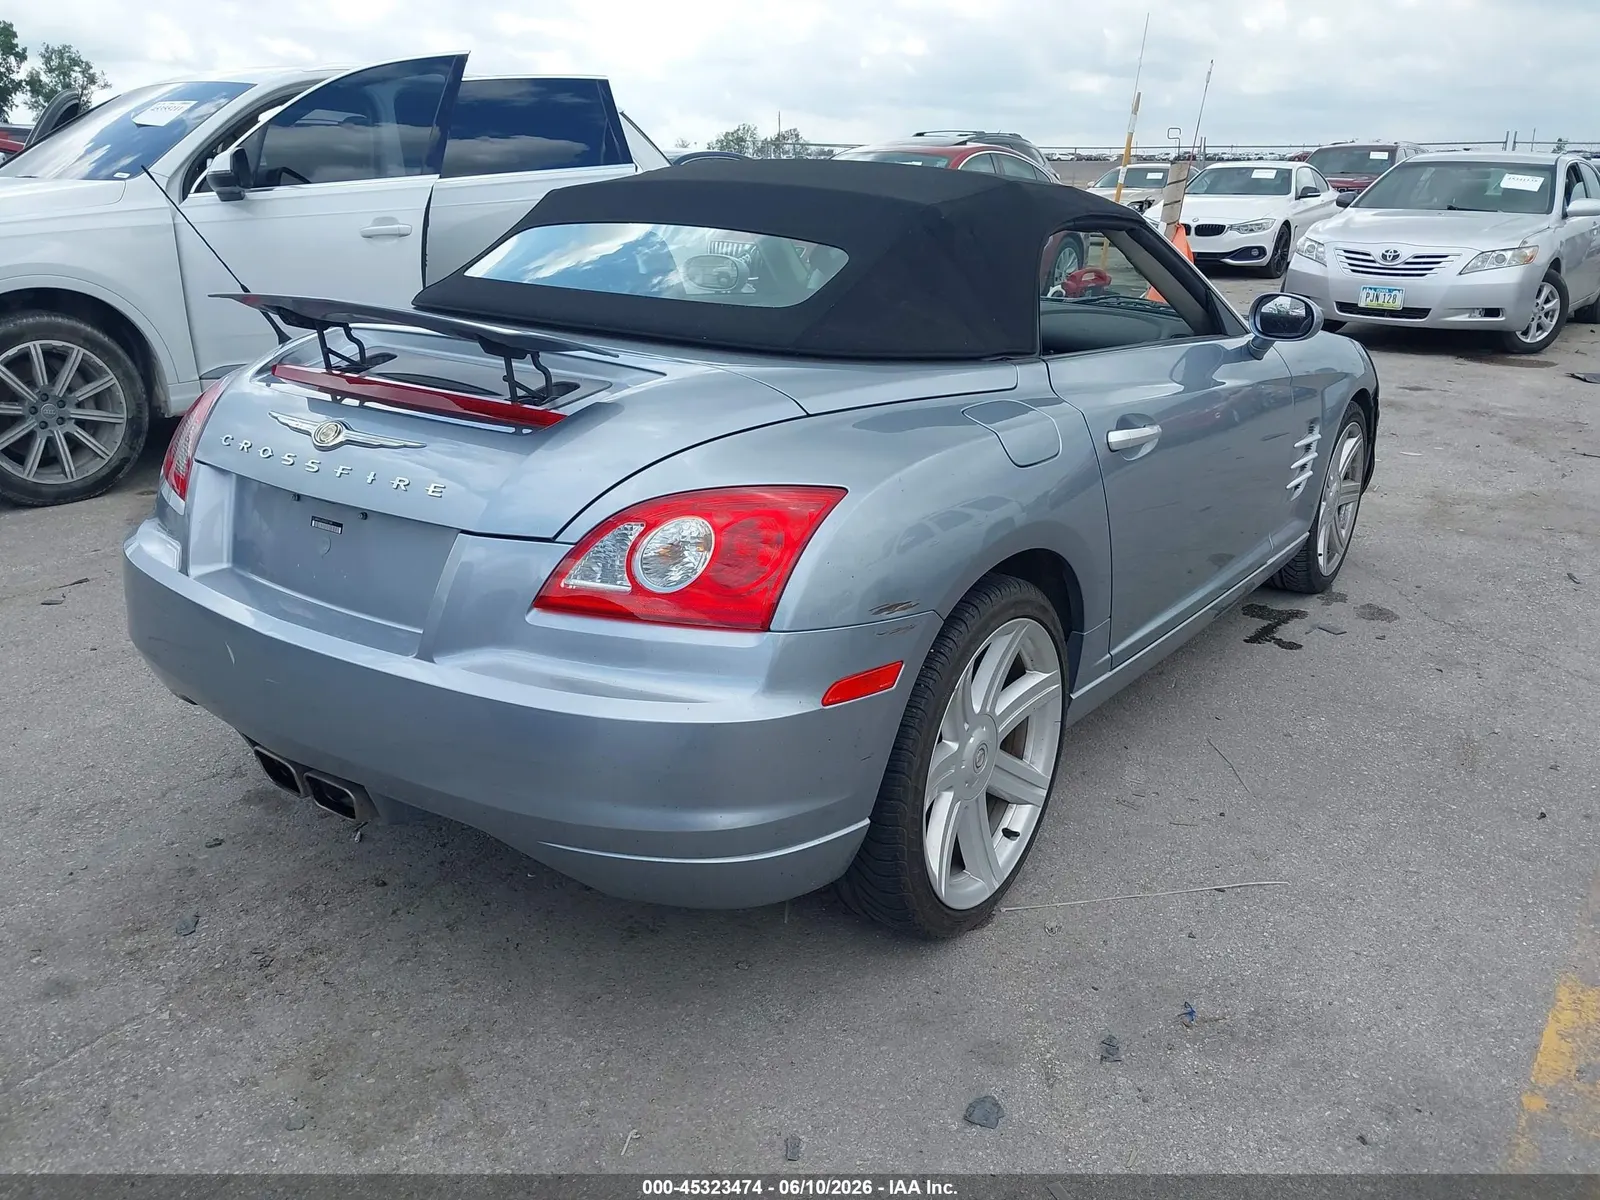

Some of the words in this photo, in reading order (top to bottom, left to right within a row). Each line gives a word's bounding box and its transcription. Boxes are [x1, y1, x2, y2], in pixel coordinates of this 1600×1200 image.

[1365, 292, 1379, 303] PJN
[1382, 293, 1397, 304] 128
[219, 434, 446, 498] CROSSFIRE
